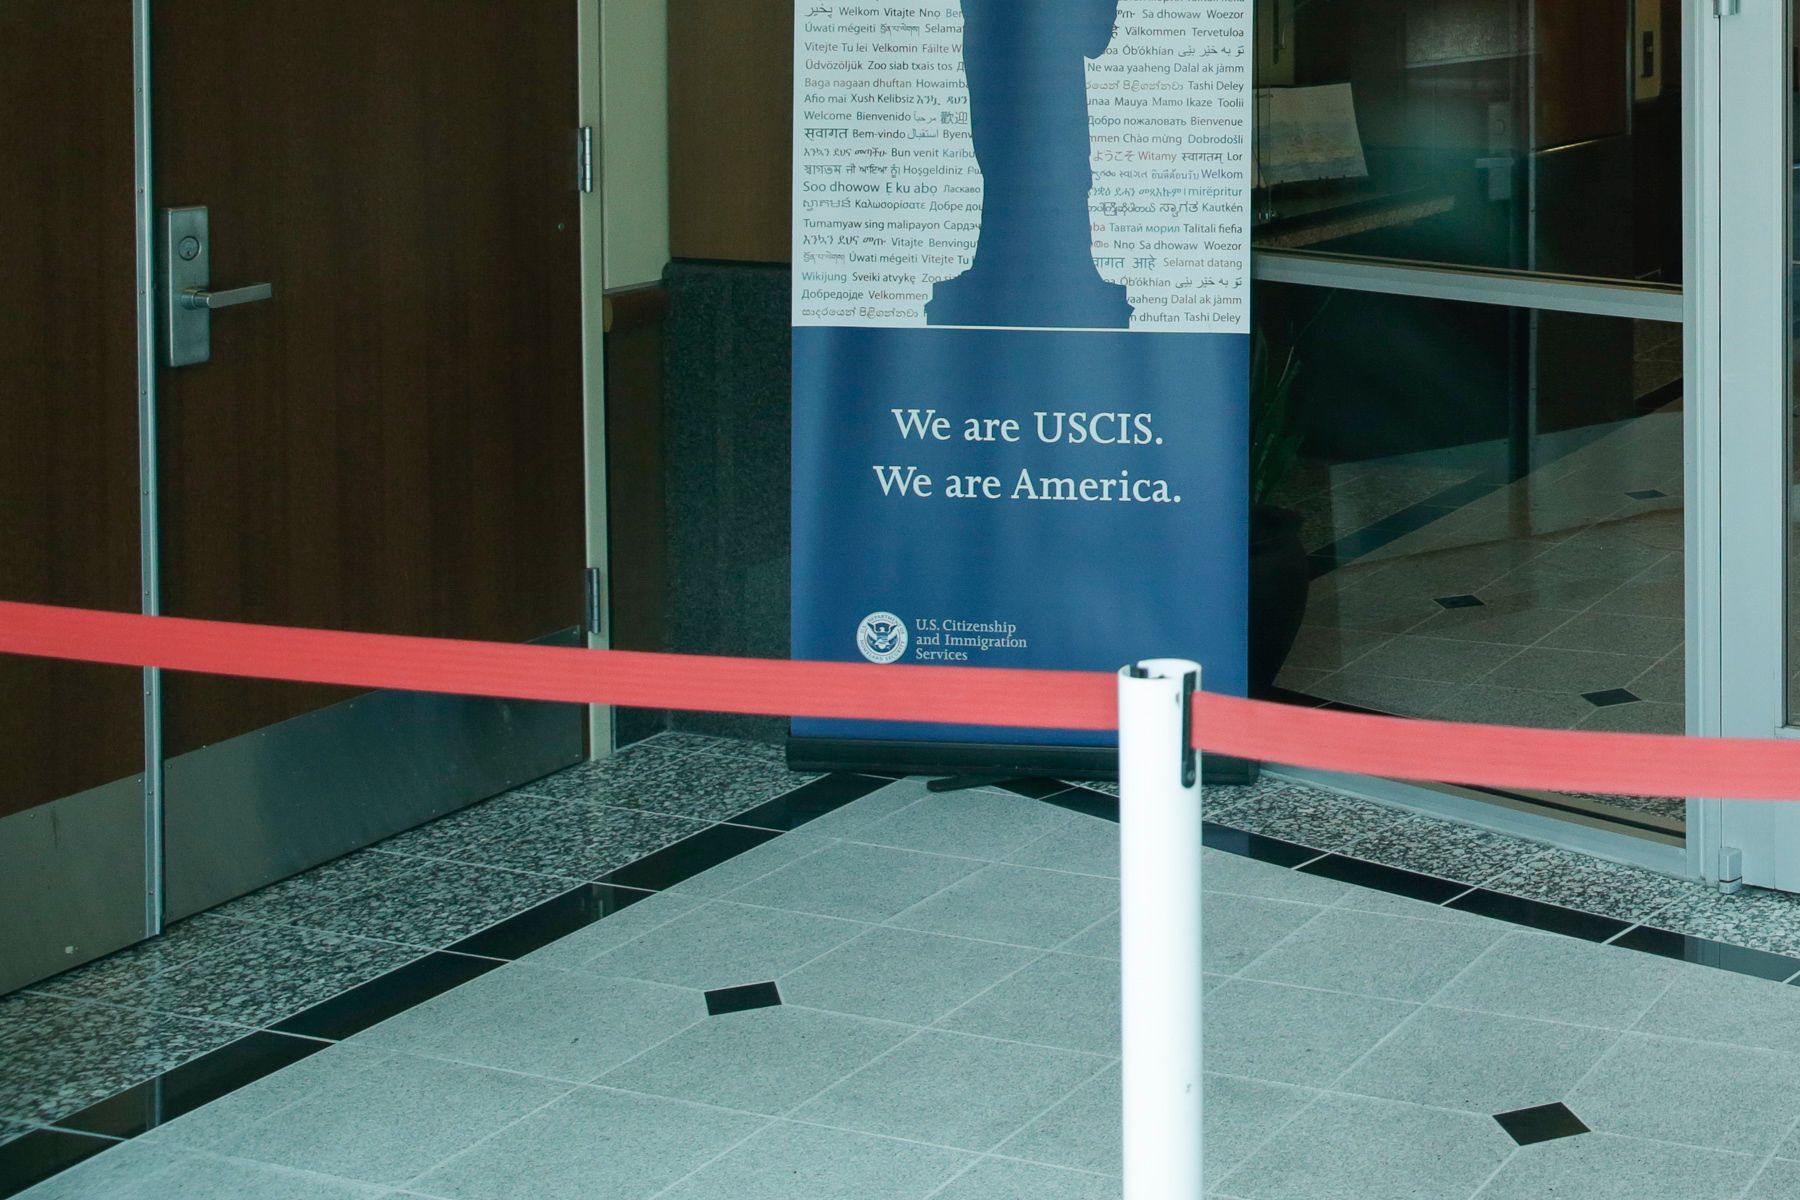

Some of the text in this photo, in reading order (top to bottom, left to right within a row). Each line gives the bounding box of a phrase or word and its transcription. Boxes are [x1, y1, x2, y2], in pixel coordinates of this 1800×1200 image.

[883, 7, 916, 21] Vitajte
[921, 43, 949, 54] Fáilte
[873, 77, 912, 89] dhuftan
[828, 94, 847, 103] mai
[851, 93, 875, 104] Xush
[877, 90, 914, 104] Kelibsiz
[852, 128, 906, 140] Bem-vindo
[913, 148, 939, 157] venit
[803, 218, 862, 231] Tumamyaw
[802, 272, 847, 284] Wikijung
[851, 272, 880, 282] Sveiki
[868, 290, 928, 302] Velkommen
[892, 409, 1164, 445] We are USCIS.
[873, 465, 1182, 503] We are America.
[916, 619, 1017, 637] U.S. Citizenship
[916, 634, 1027, 651] and Immigration
[916, 648, 968, 661] Services
